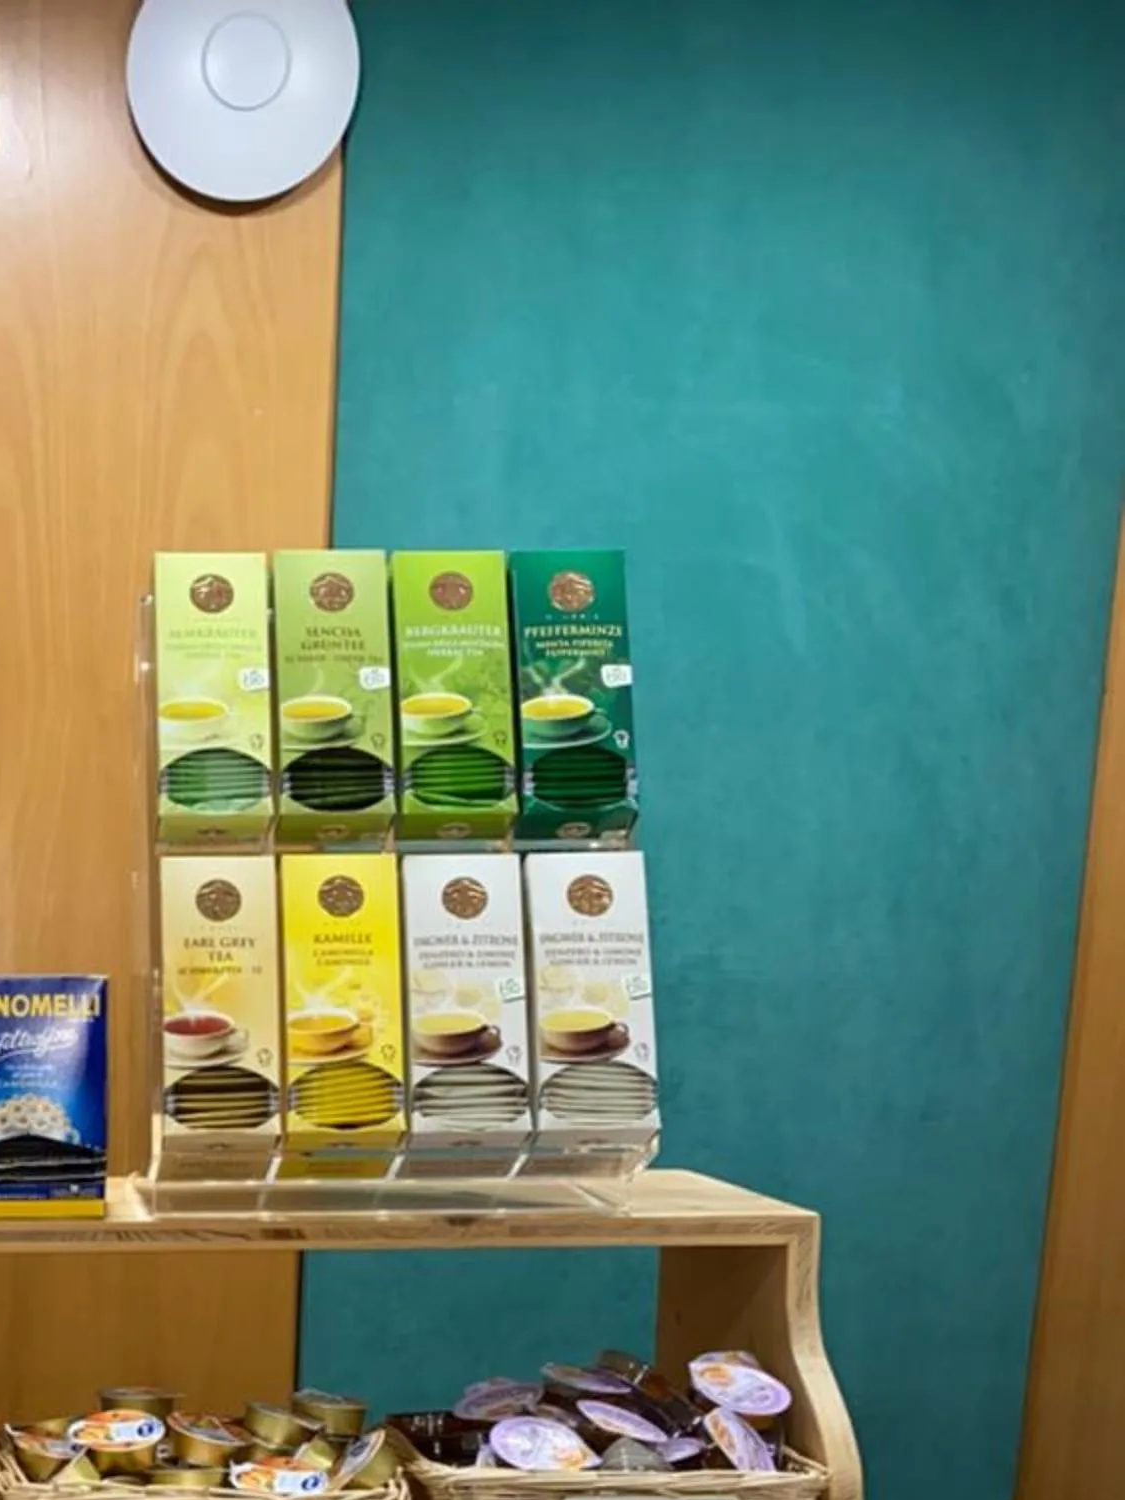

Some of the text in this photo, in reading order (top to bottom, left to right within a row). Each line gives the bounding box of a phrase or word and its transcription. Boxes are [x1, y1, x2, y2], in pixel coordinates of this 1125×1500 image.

[183, 937, 256, 949] EARL GREY
[314, 933, 372, 944] KAMILLE
[208, 951, 234, 962] TEA
